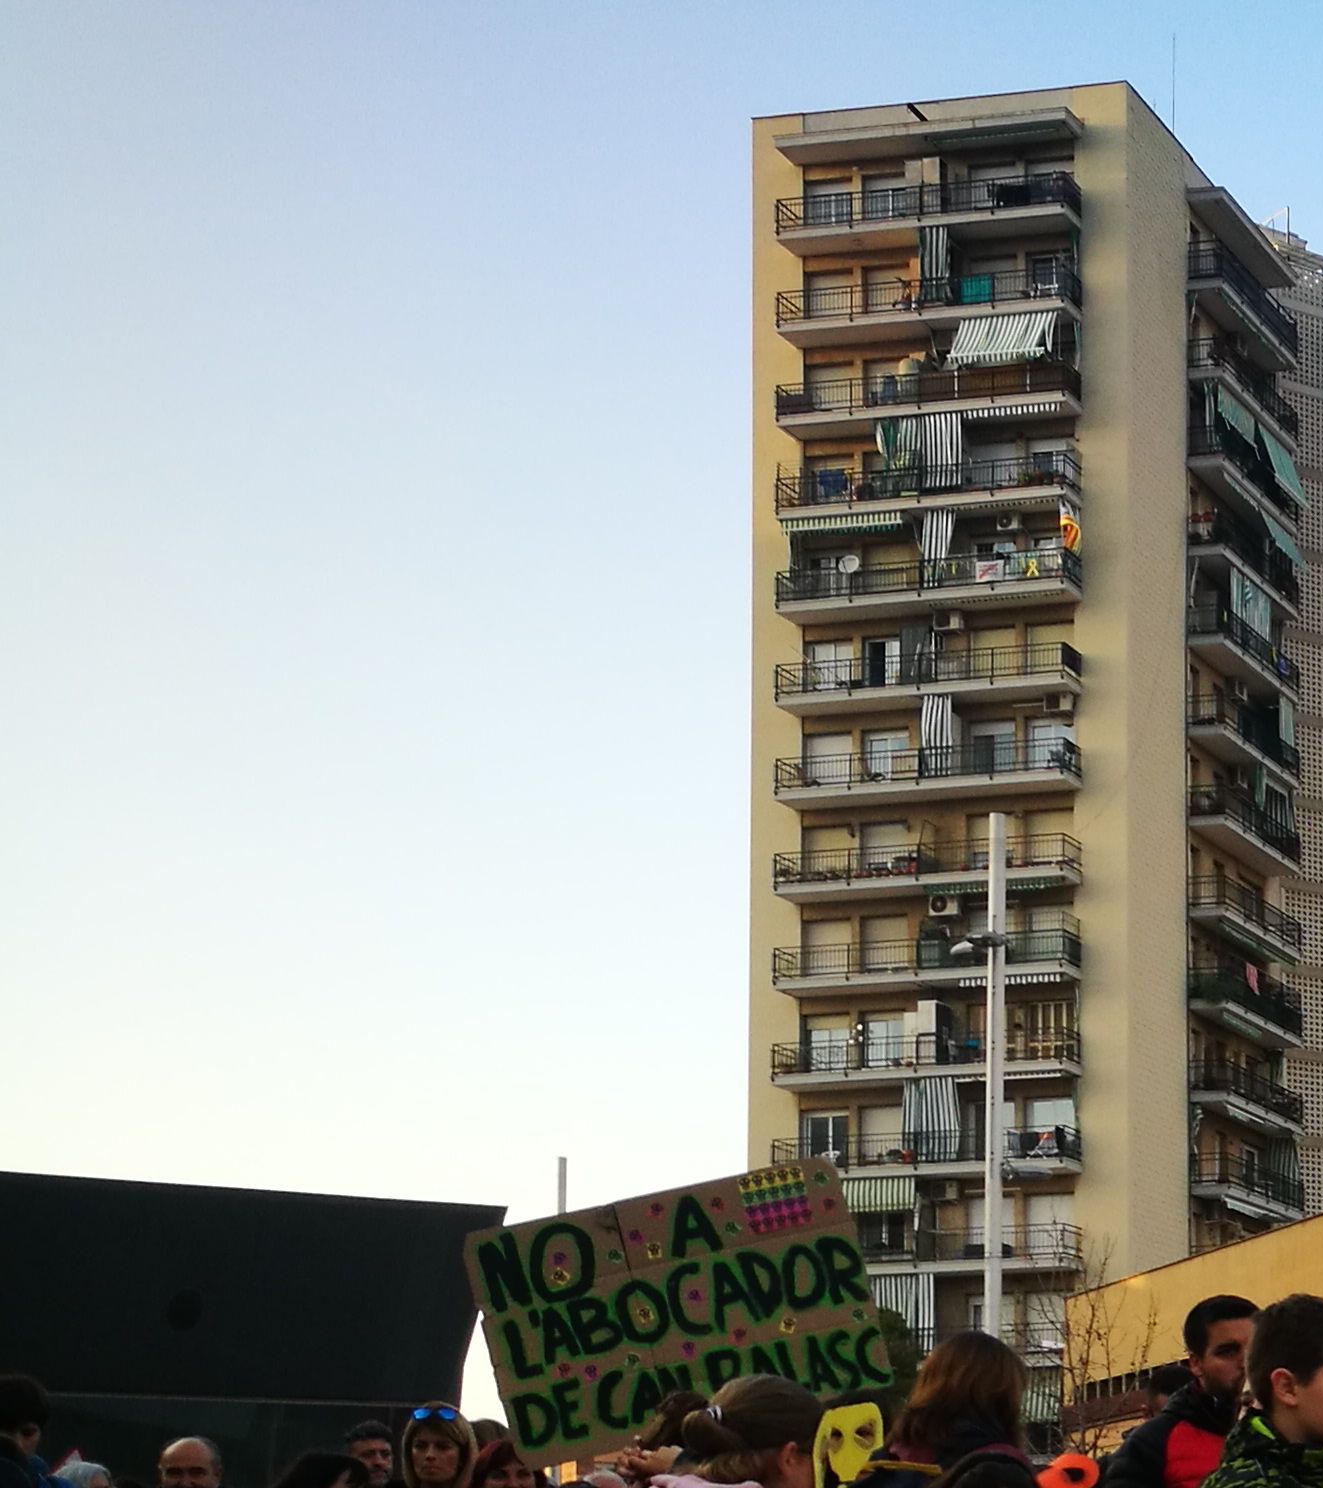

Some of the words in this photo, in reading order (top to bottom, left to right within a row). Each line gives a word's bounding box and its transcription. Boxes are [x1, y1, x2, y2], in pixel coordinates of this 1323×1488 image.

[479, 1223, 595, 1312] NO
[671, 1196, 723, 1258] A
[502, 1237, 870, 1381] L'ABOCADOR
[512, 1378, 589, 1447] DE
